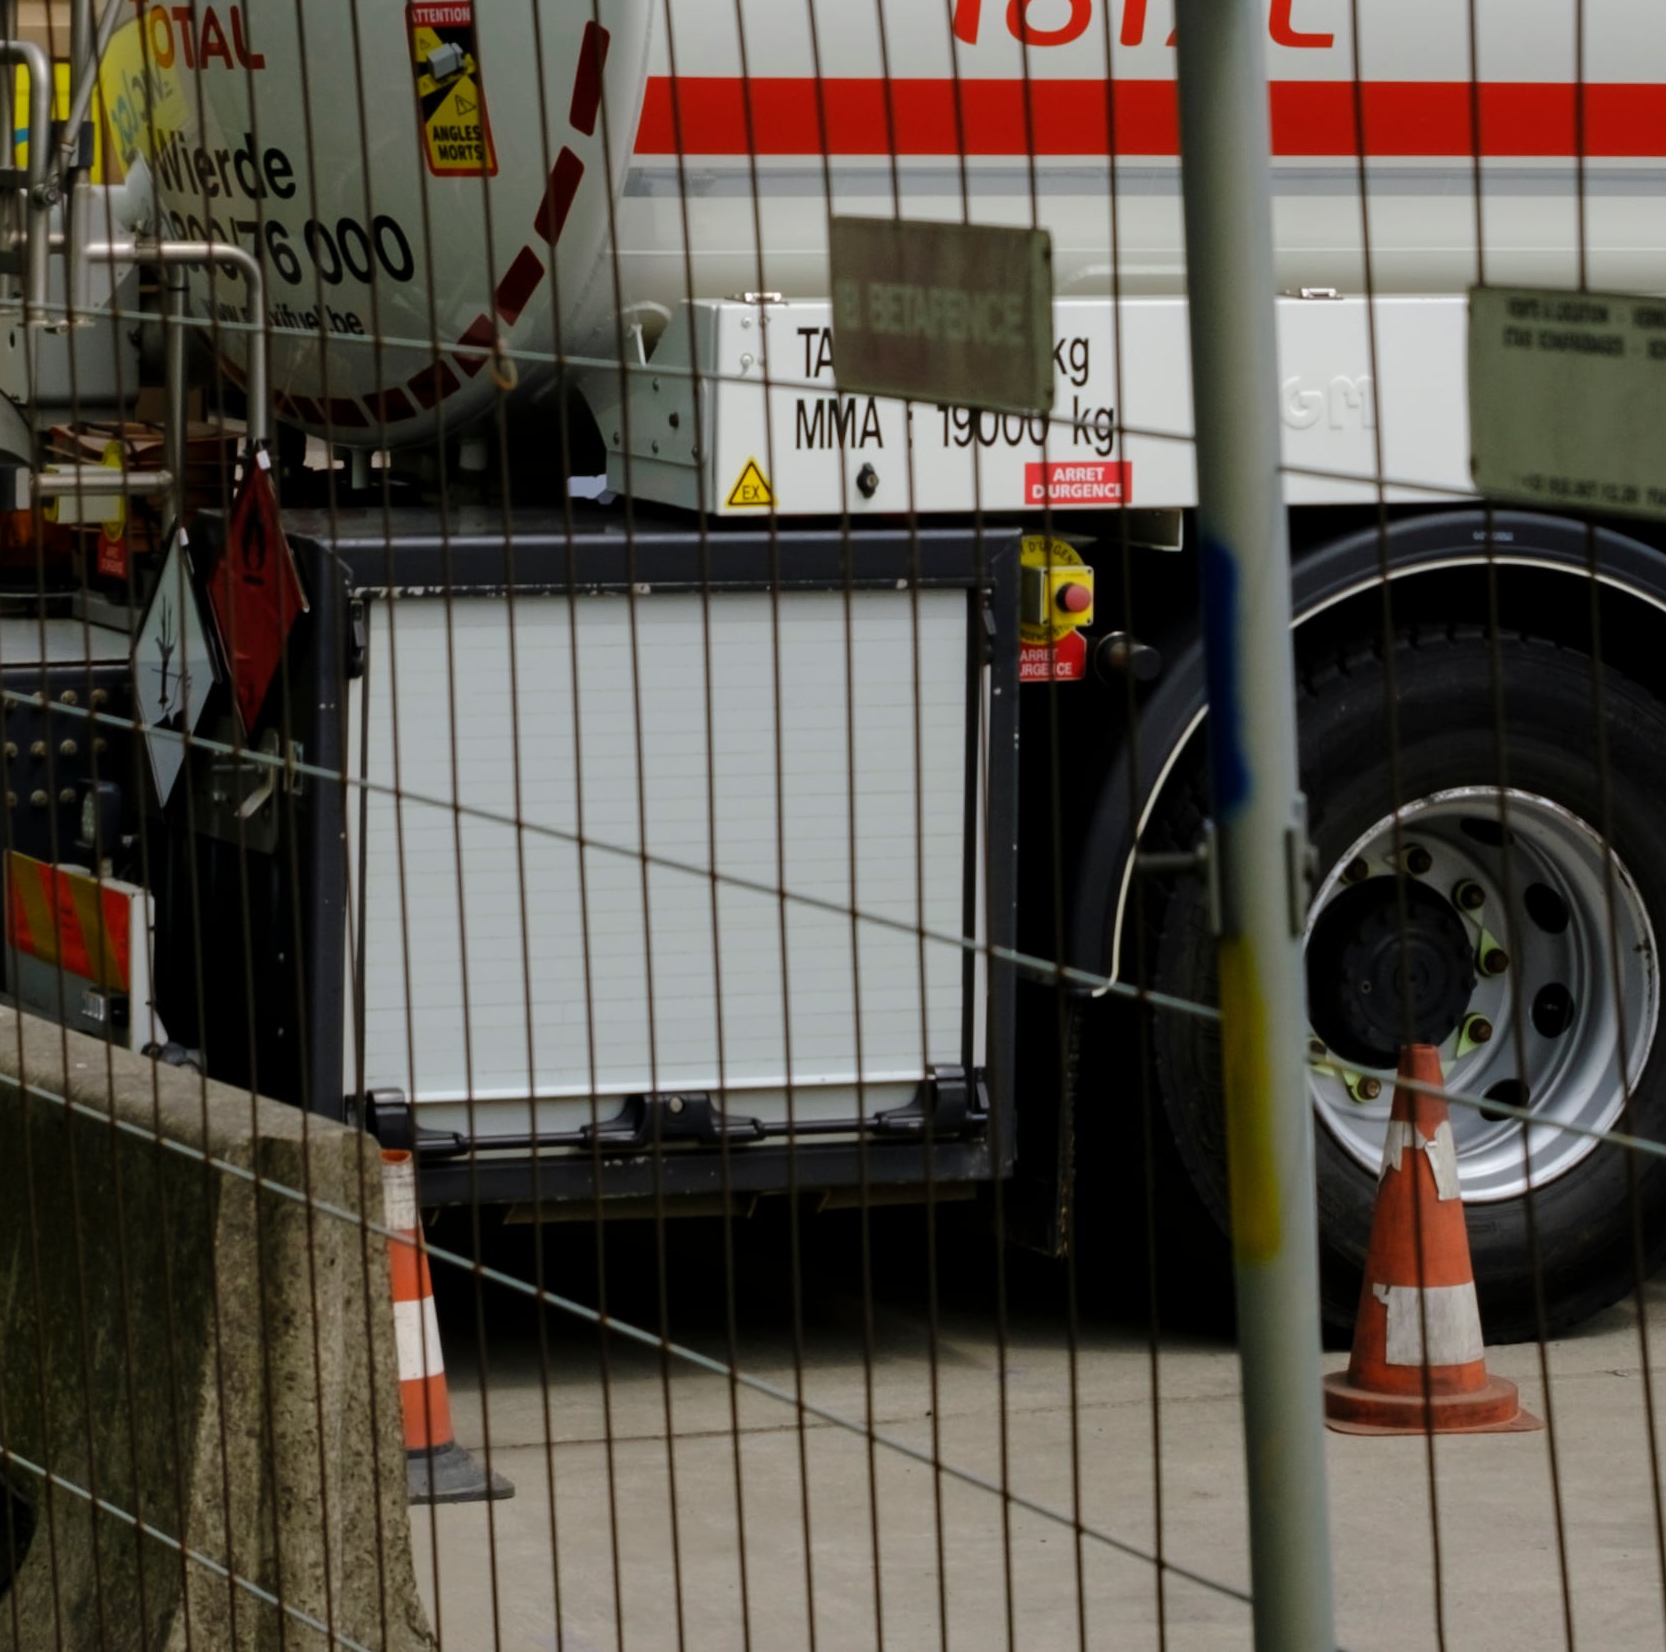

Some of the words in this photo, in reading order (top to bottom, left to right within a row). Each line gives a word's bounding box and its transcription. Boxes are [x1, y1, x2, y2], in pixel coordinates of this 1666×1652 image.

[432, 125, 482, 142] ANGLES
[438, 144, 484, 162] MORTS
[148, 126, 297, 200] Wierde
[796, 398, 884, 449] MMA
[1073, 396, 1115, 457] kg
[1053, 466, 1105, 482] ARRET
[741, 484, 761, 501] EX
